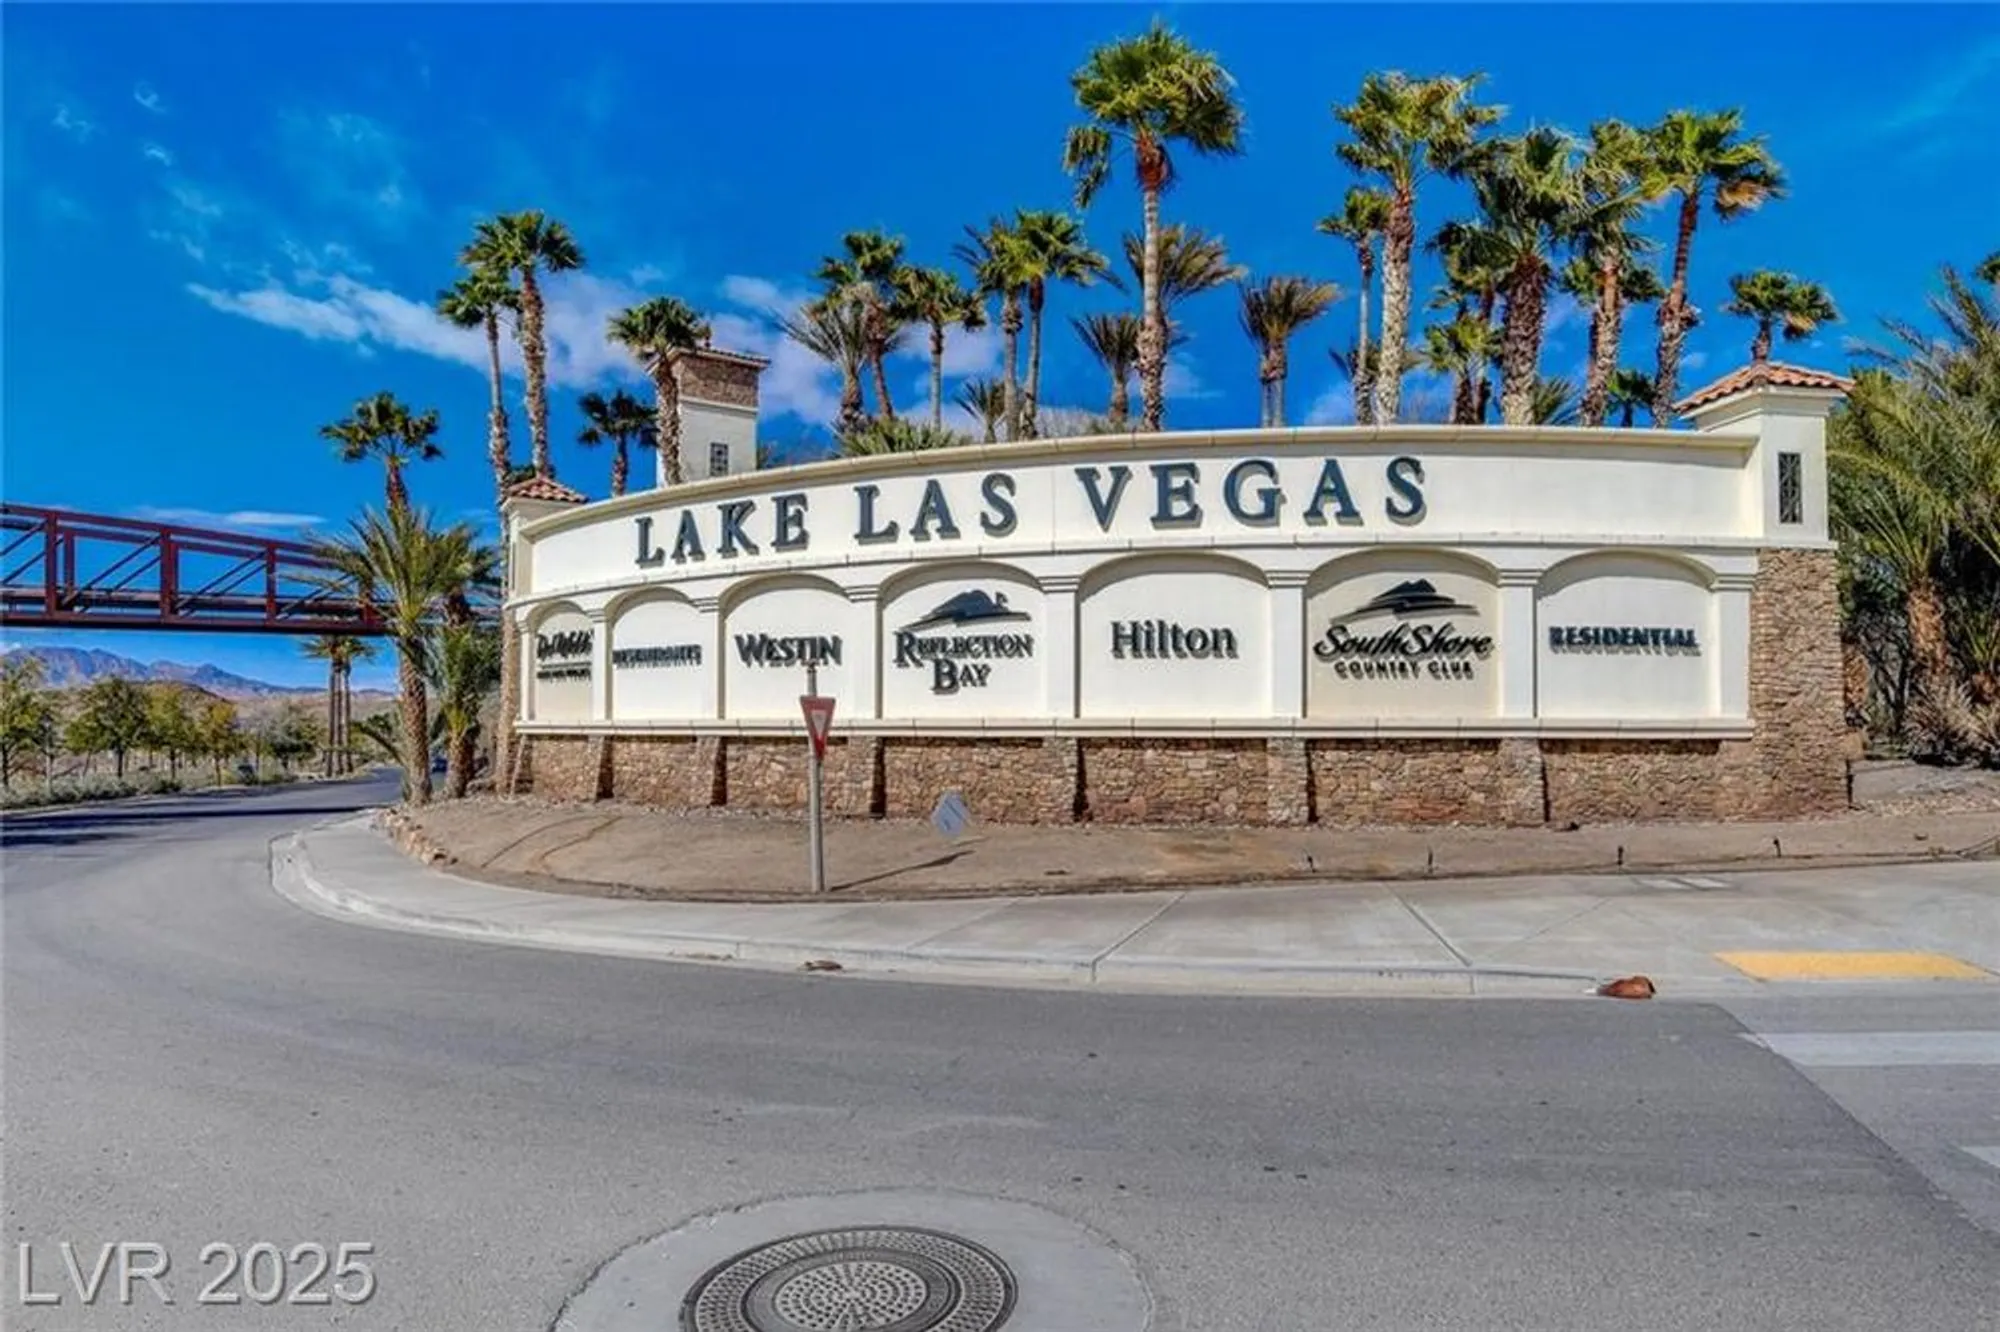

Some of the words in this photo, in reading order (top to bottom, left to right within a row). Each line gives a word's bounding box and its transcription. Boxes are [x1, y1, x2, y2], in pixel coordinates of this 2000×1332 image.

[635, 493, 809, 567] LAKE
[853, 473, 1017, 543] LAS
[1074, 457, 1426, 532] VEGAS
[735, 634, 842, 666] WESTIN
[893, 631, 1034, 667] REFLECTION
[1110, 619, 1238, 658] Hilton
[1313, 622, 1409, 660] South
[1402, 622, 1493, 659] Shore
[1549, 626, 1700, 652] RESIDENTIAL
[932, 658, 991, 693] BAY
[1334, 661, 1420, 677] COUNTRY
